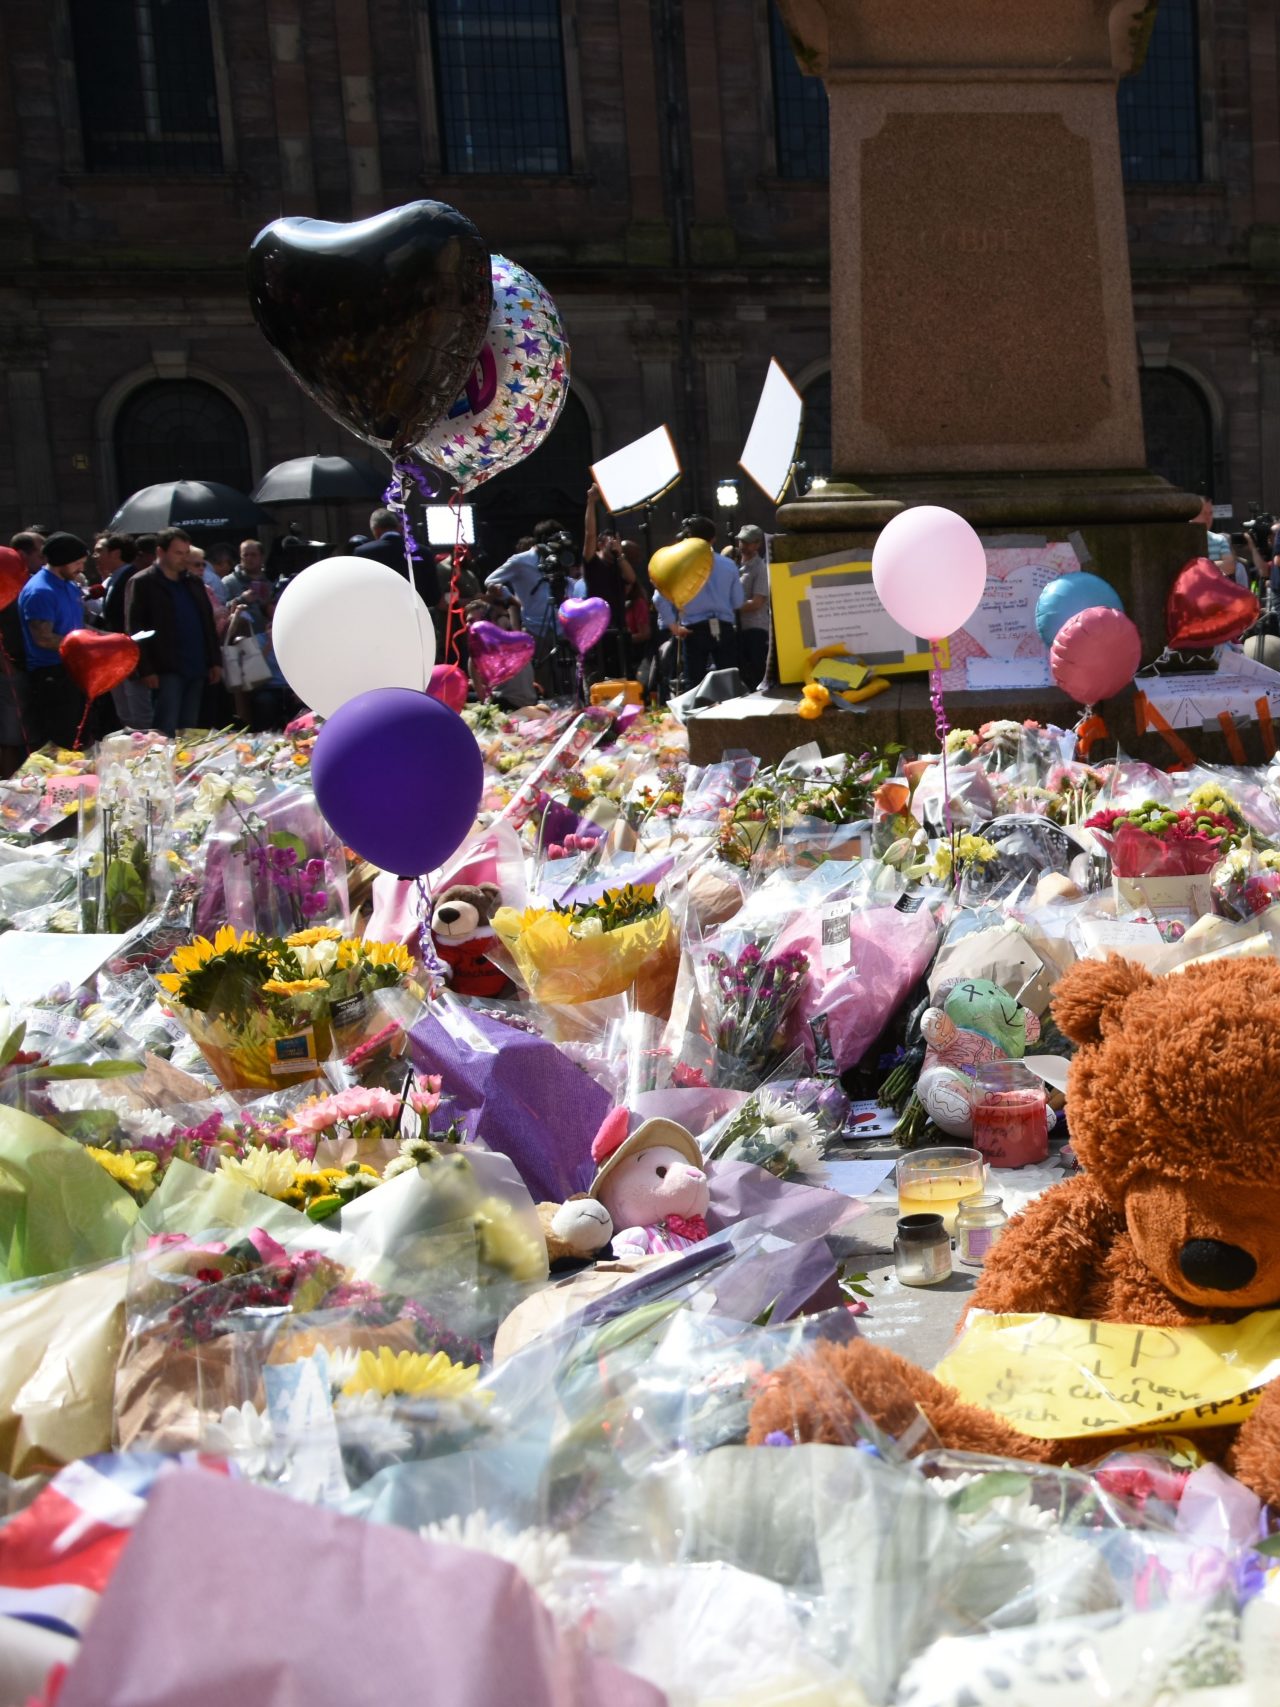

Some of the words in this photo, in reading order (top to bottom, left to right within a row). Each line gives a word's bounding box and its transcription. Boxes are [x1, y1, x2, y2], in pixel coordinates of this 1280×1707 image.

[181, 517, 230, 526] DUNLOP
[1019, 1315, 1182, 1368] RIP
[1068, 1383, 1146, 1408] and
